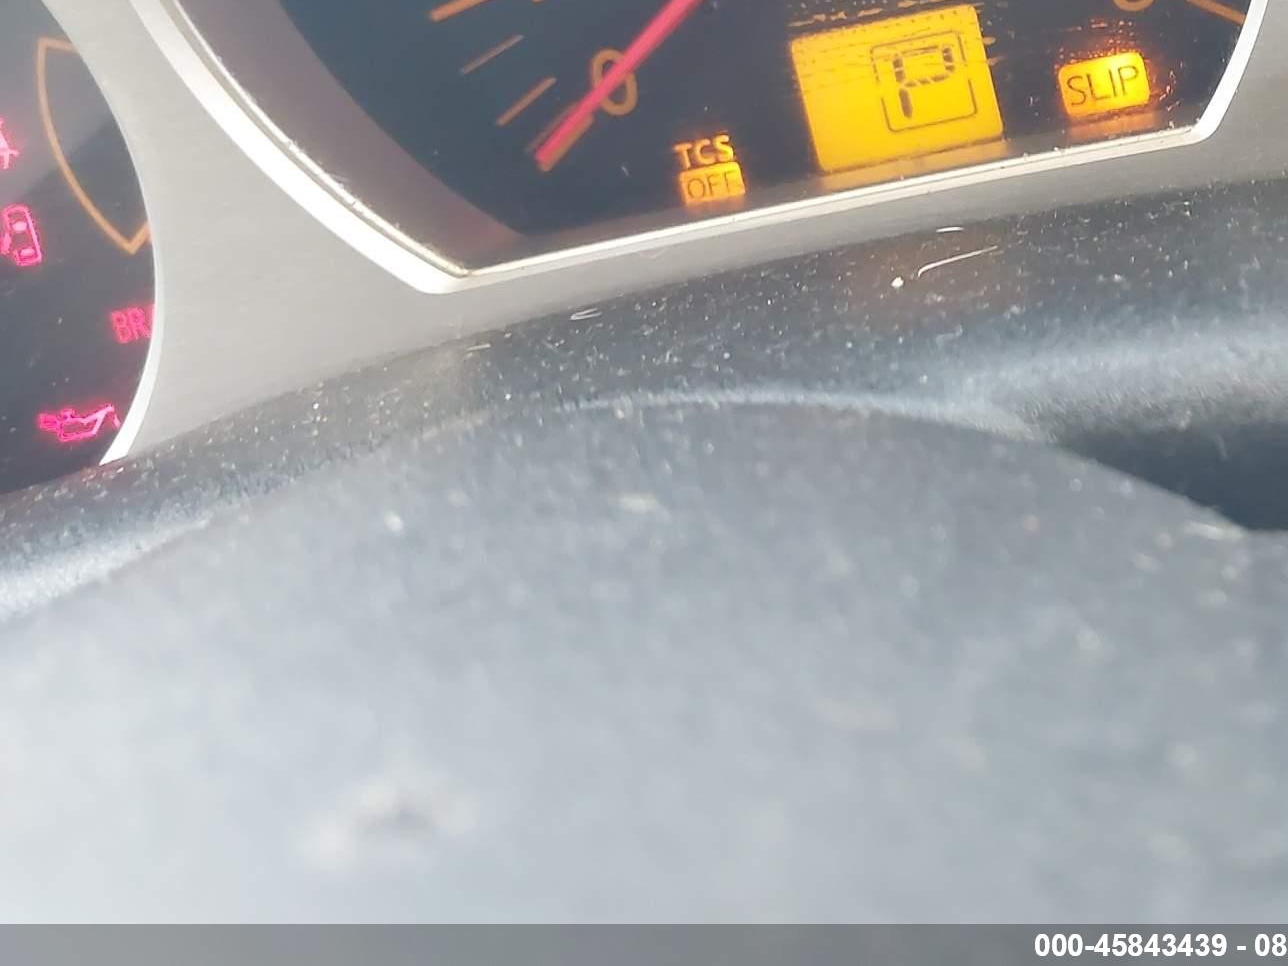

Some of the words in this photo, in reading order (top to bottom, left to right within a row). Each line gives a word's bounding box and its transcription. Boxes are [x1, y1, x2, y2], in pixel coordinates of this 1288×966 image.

[892, 45, 956, 121] P
[1066, 64, 1140, 107] SLIP
[673, 133, 734, 170] TCS
[687, 169, 740, 198] OFF
